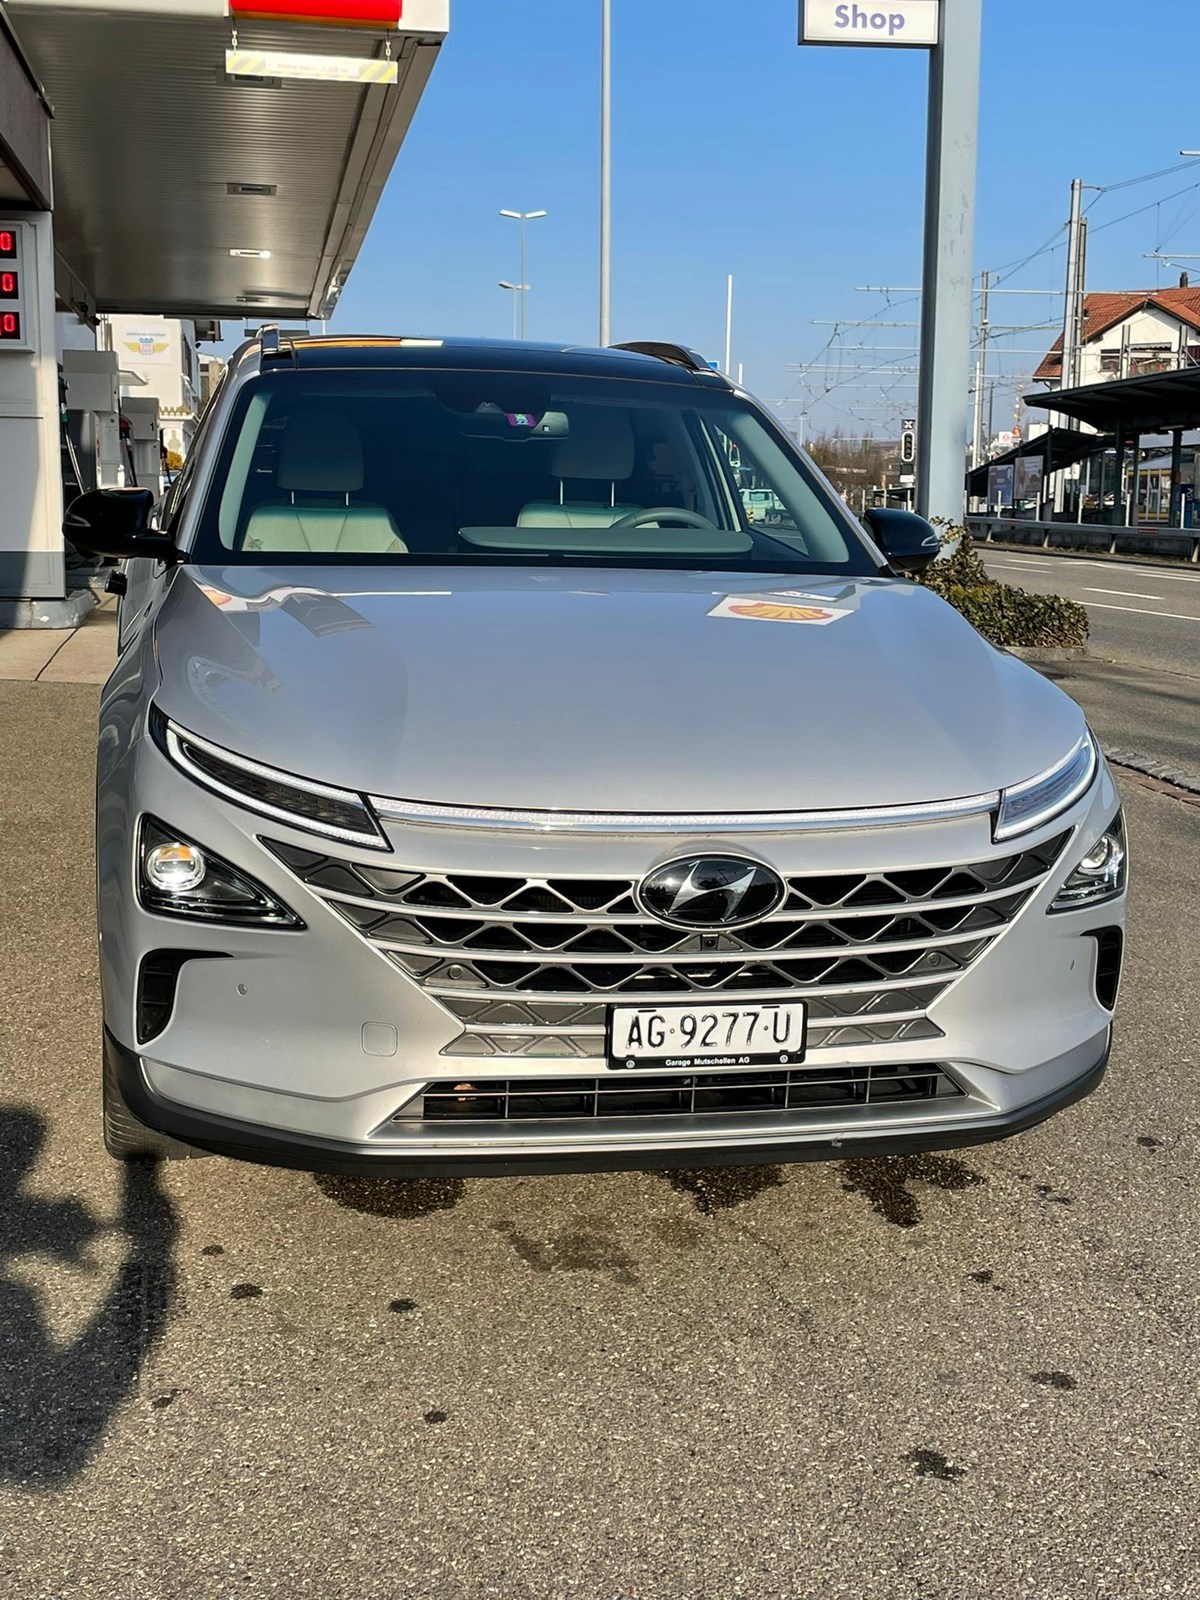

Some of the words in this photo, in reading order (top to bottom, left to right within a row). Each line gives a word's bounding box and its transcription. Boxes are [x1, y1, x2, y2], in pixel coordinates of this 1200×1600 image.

[834, 4, 905, 36] Shop
[150, 422, 155, 432] 1
[665, 1058, 691, 1067] Garage
[694, 1057, 736, 1065] Mutschellen
